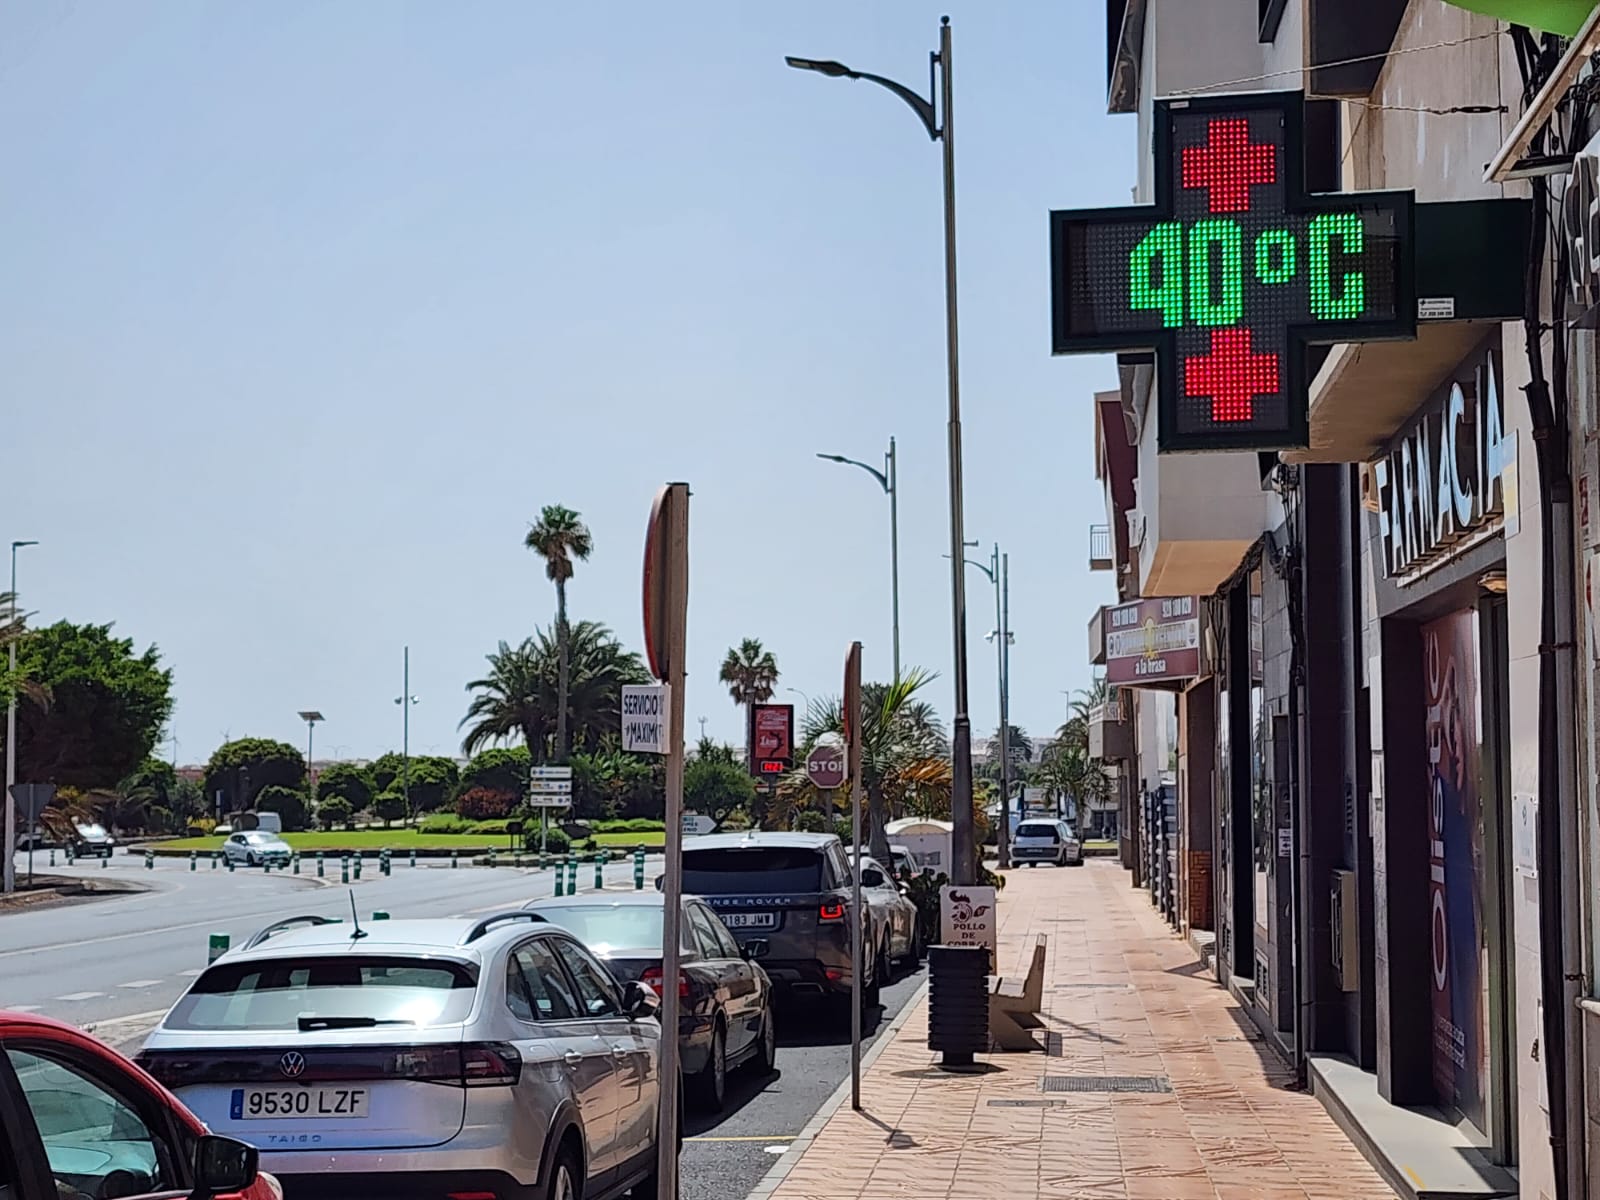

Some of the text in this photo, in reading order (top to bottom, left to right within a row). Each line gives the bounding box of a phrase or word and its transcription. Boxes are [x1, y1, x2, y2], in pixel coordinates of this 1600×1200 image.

[1374, 349, 1503, 580] FARMACIA
[623, 694, 658, 716] SERVICIO
[953, 923, 986, 931] POLLO
[961, 932, 976, 940] DE
[249, 1092, 309, 1114] 9530
[318, 1091, 365, 1113] LZF
